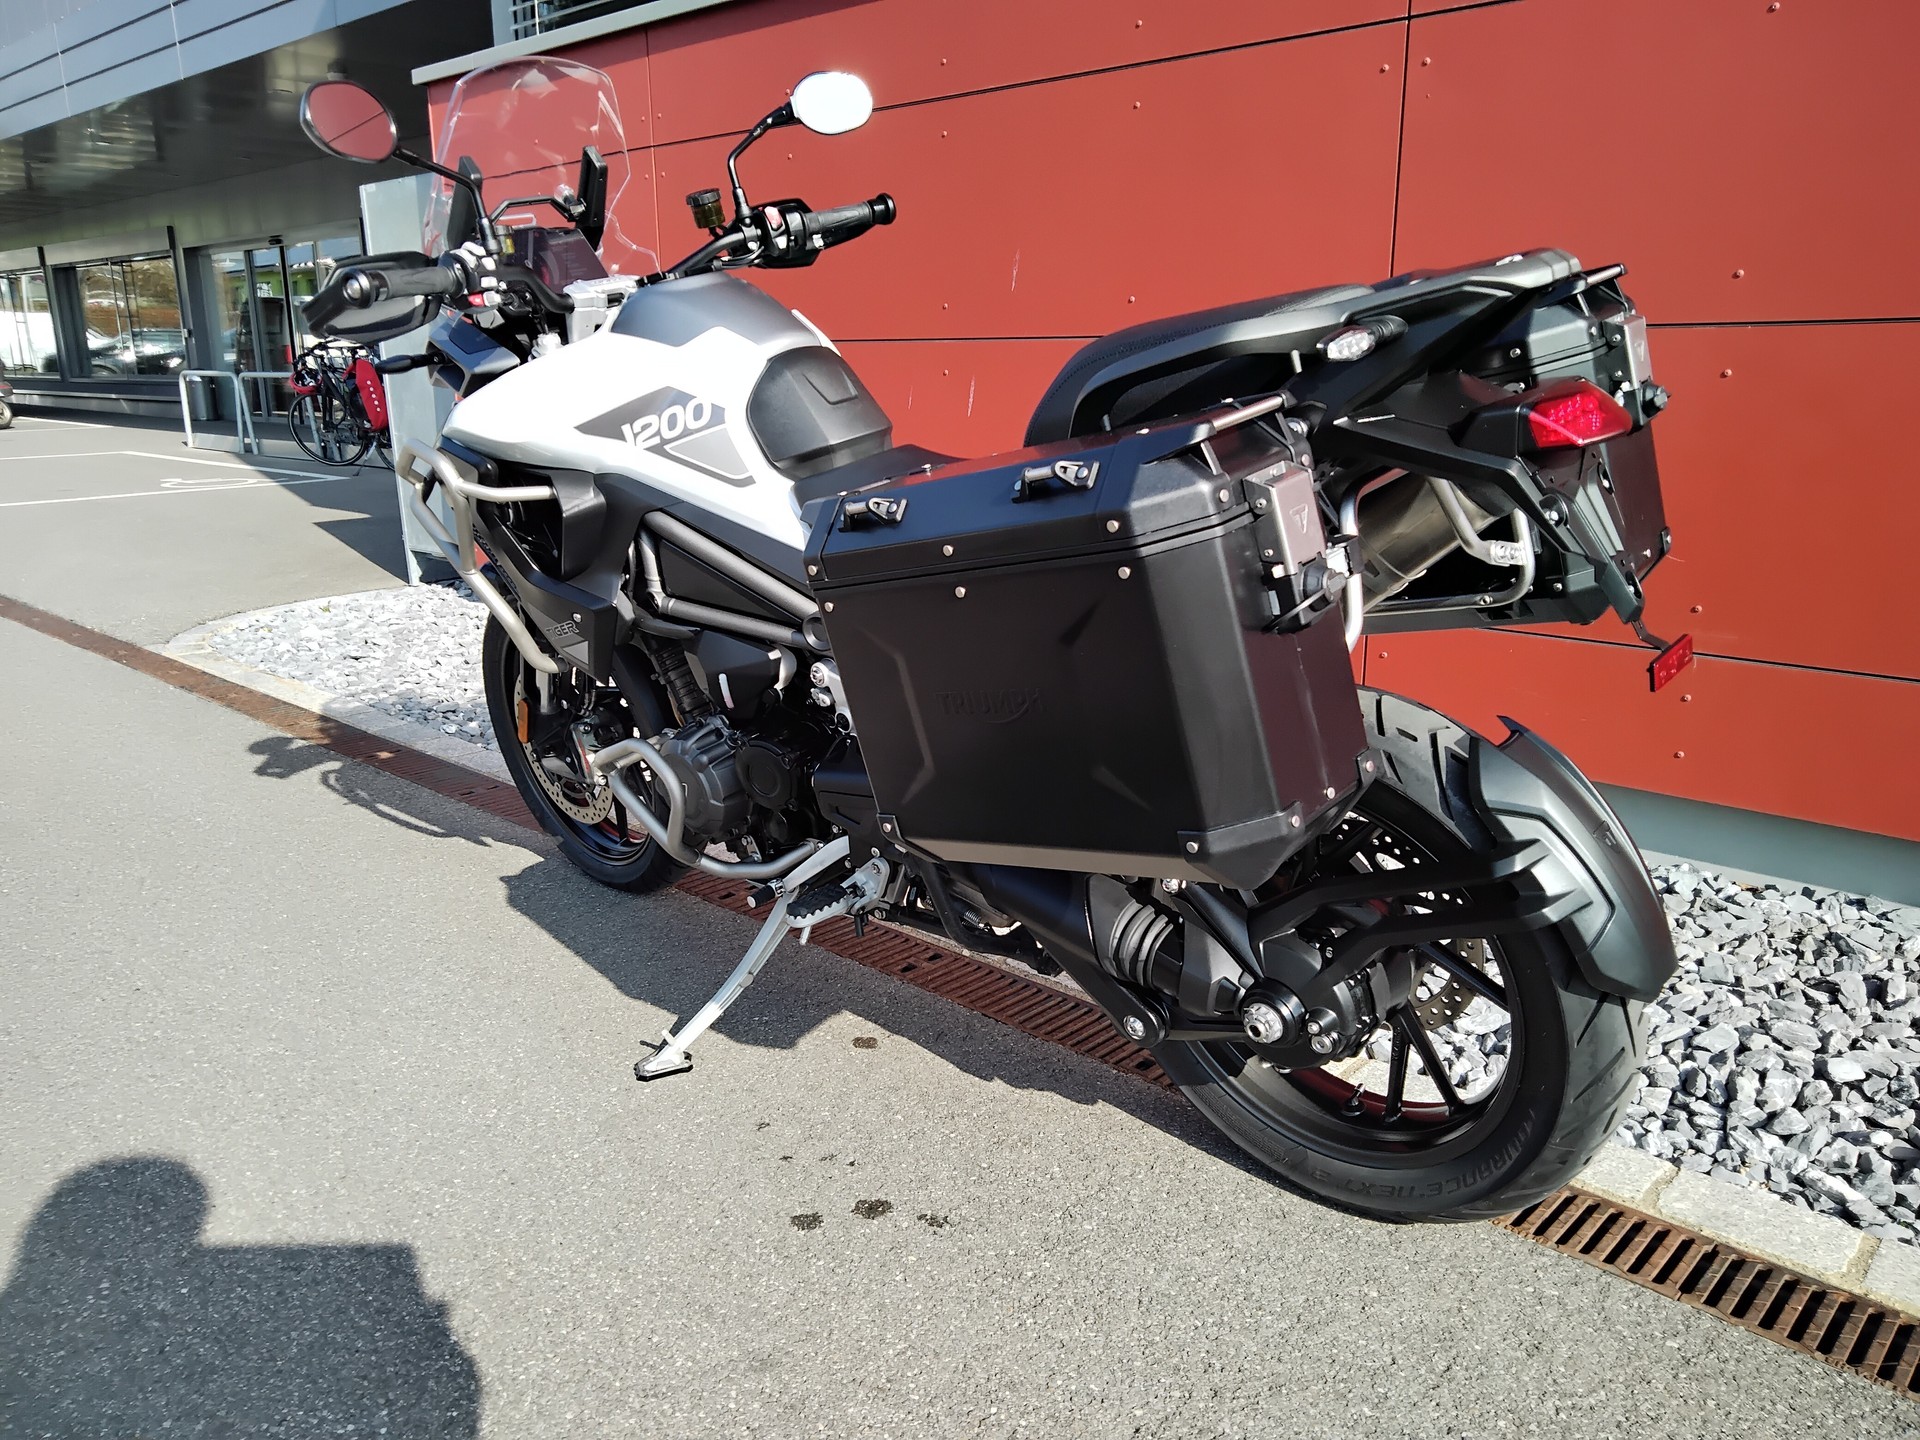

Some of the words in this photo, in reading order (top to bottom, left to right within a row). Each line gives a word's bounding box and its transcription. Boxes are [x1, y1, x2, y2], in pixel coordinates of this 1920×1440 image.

[621, 397, 712, 450] 1200
[545, 620, 580, 640] TIGER
[935, 688, 1047, 720] TRIUMPH
